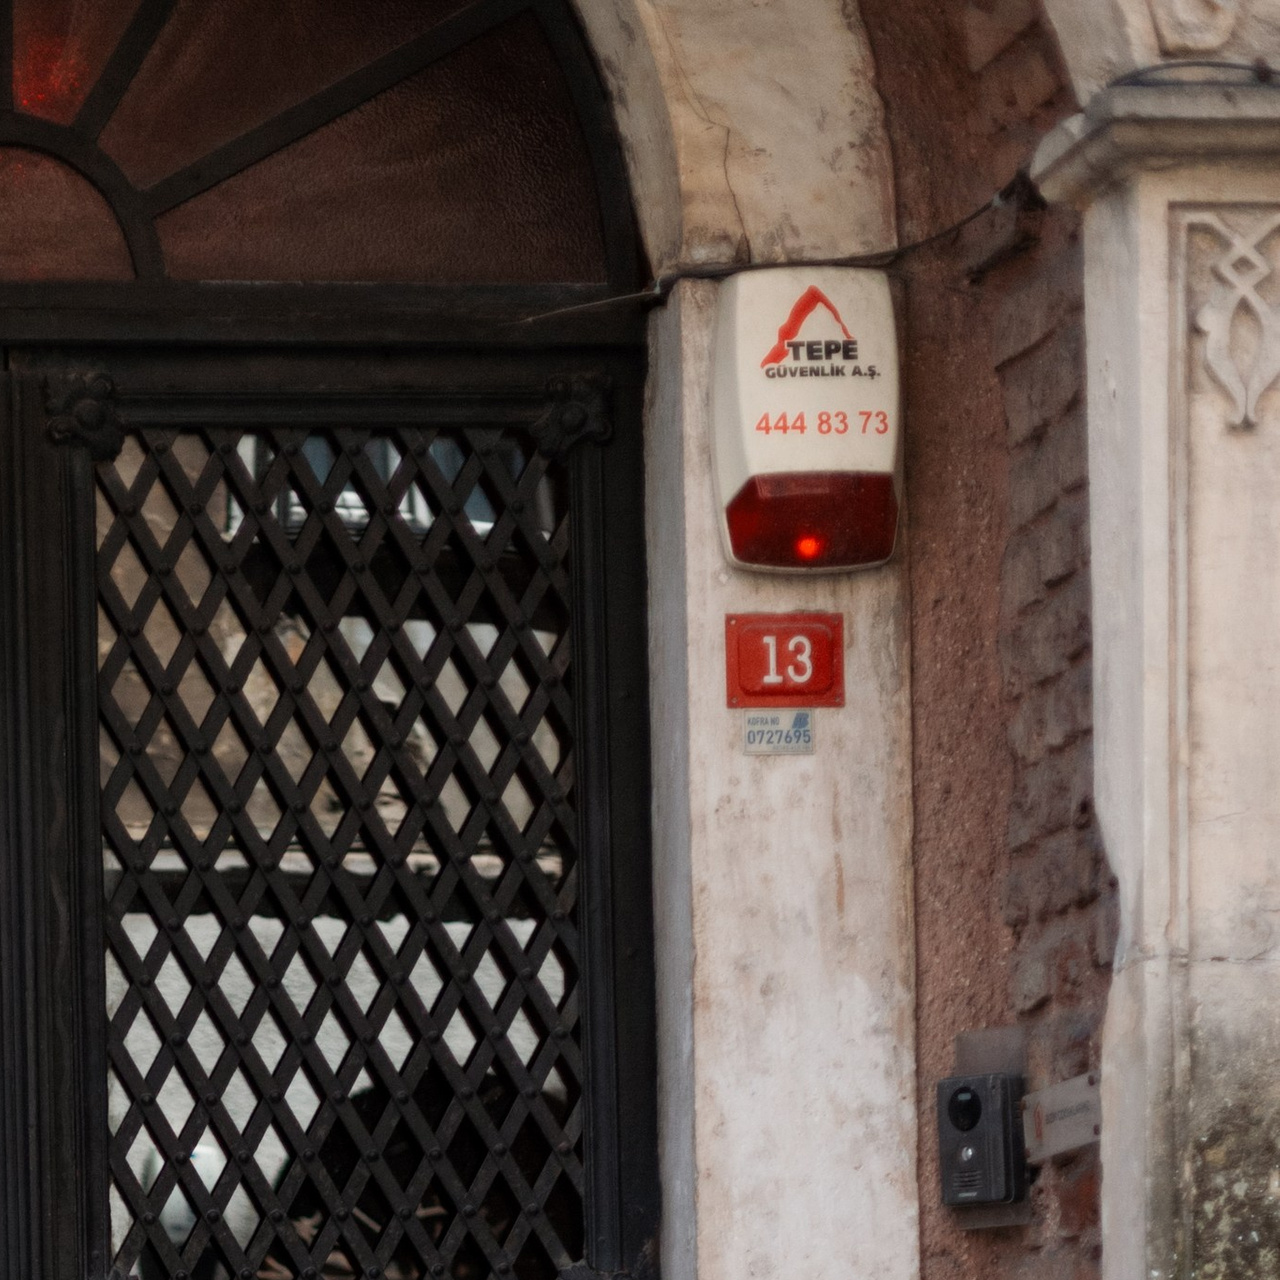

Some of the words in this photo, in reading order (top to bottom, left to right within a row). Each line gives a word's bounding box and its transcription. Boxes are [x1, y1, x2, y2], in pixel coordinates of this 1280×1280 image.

[786, 339, 859, 361] TEPE
[765, 363, 846, 379] GÜVENLİK
[851, 365, 881, 380] A.Ş.
[755, 410, 807, 435] 444
[817, 410, 849, 435] 83
[858, 410, 889, 435] 73
[762, 635, 813, 684] 13
[747, 729, 811, 745] 0727695
